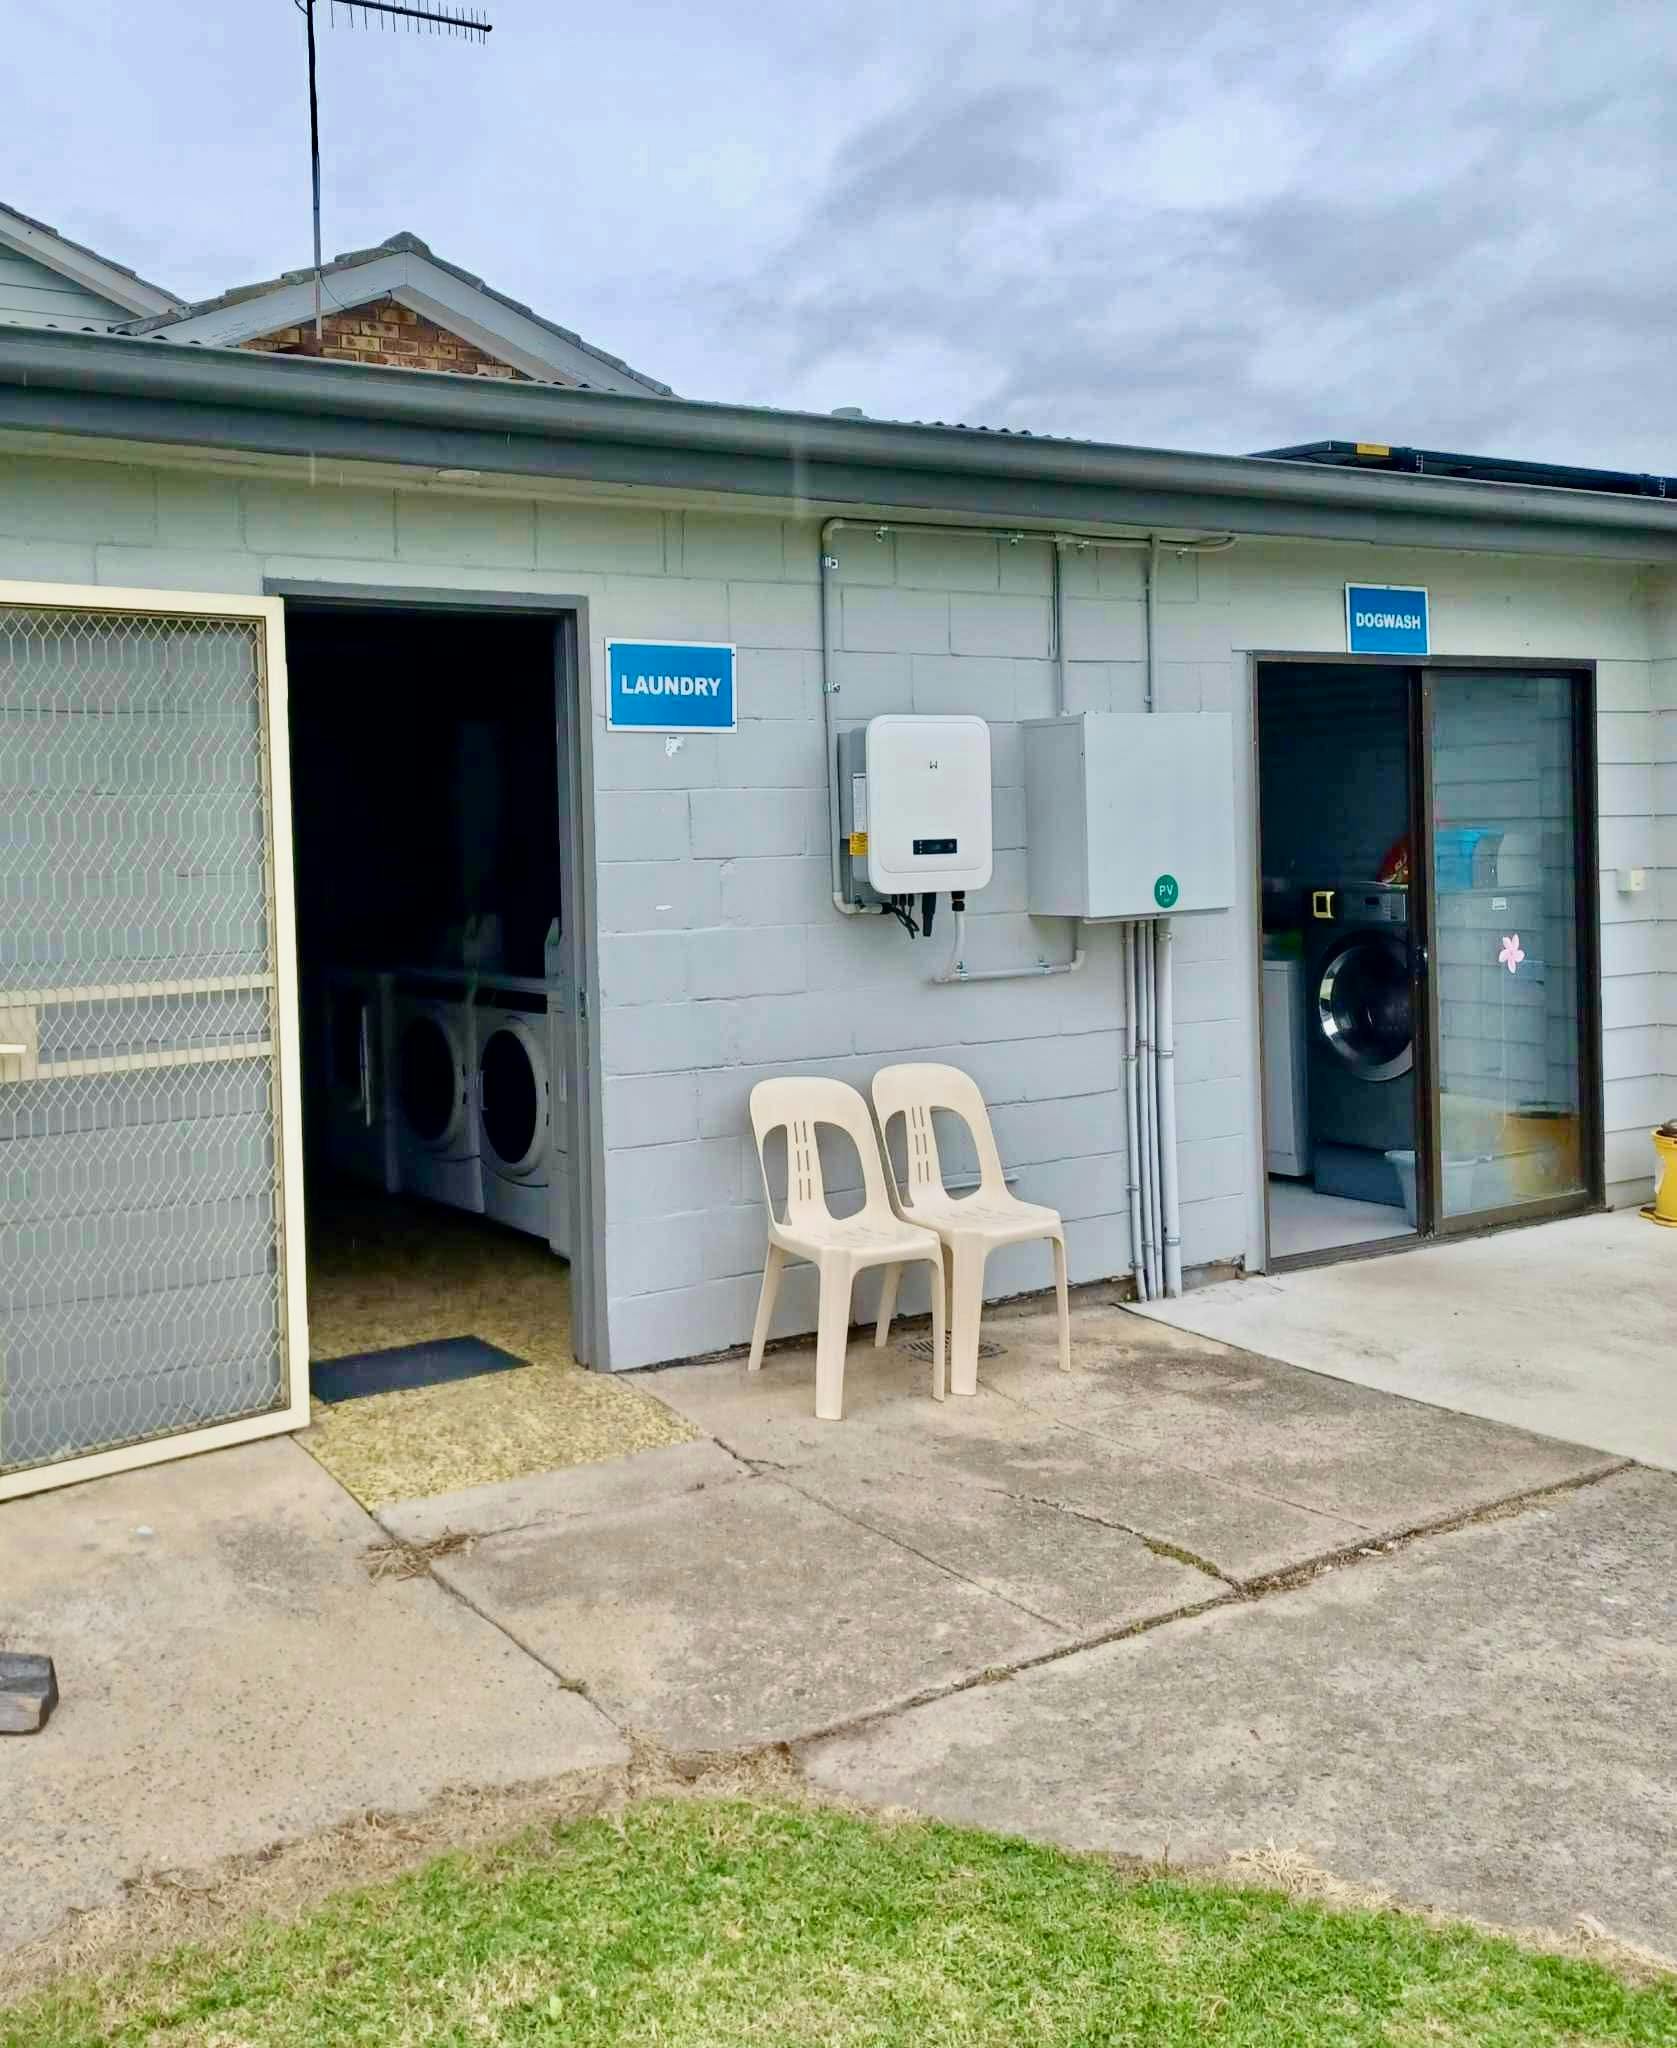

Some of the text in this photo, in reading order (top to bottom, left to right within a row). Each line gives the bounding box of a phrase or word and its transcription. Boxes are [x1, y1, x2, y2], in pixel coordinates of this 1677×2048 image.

[1355, 612, 1421, 630] DOGWASH
[621, 674, 722, 697] LAUNDRY
[1159, 884, 1174, 896] PV
